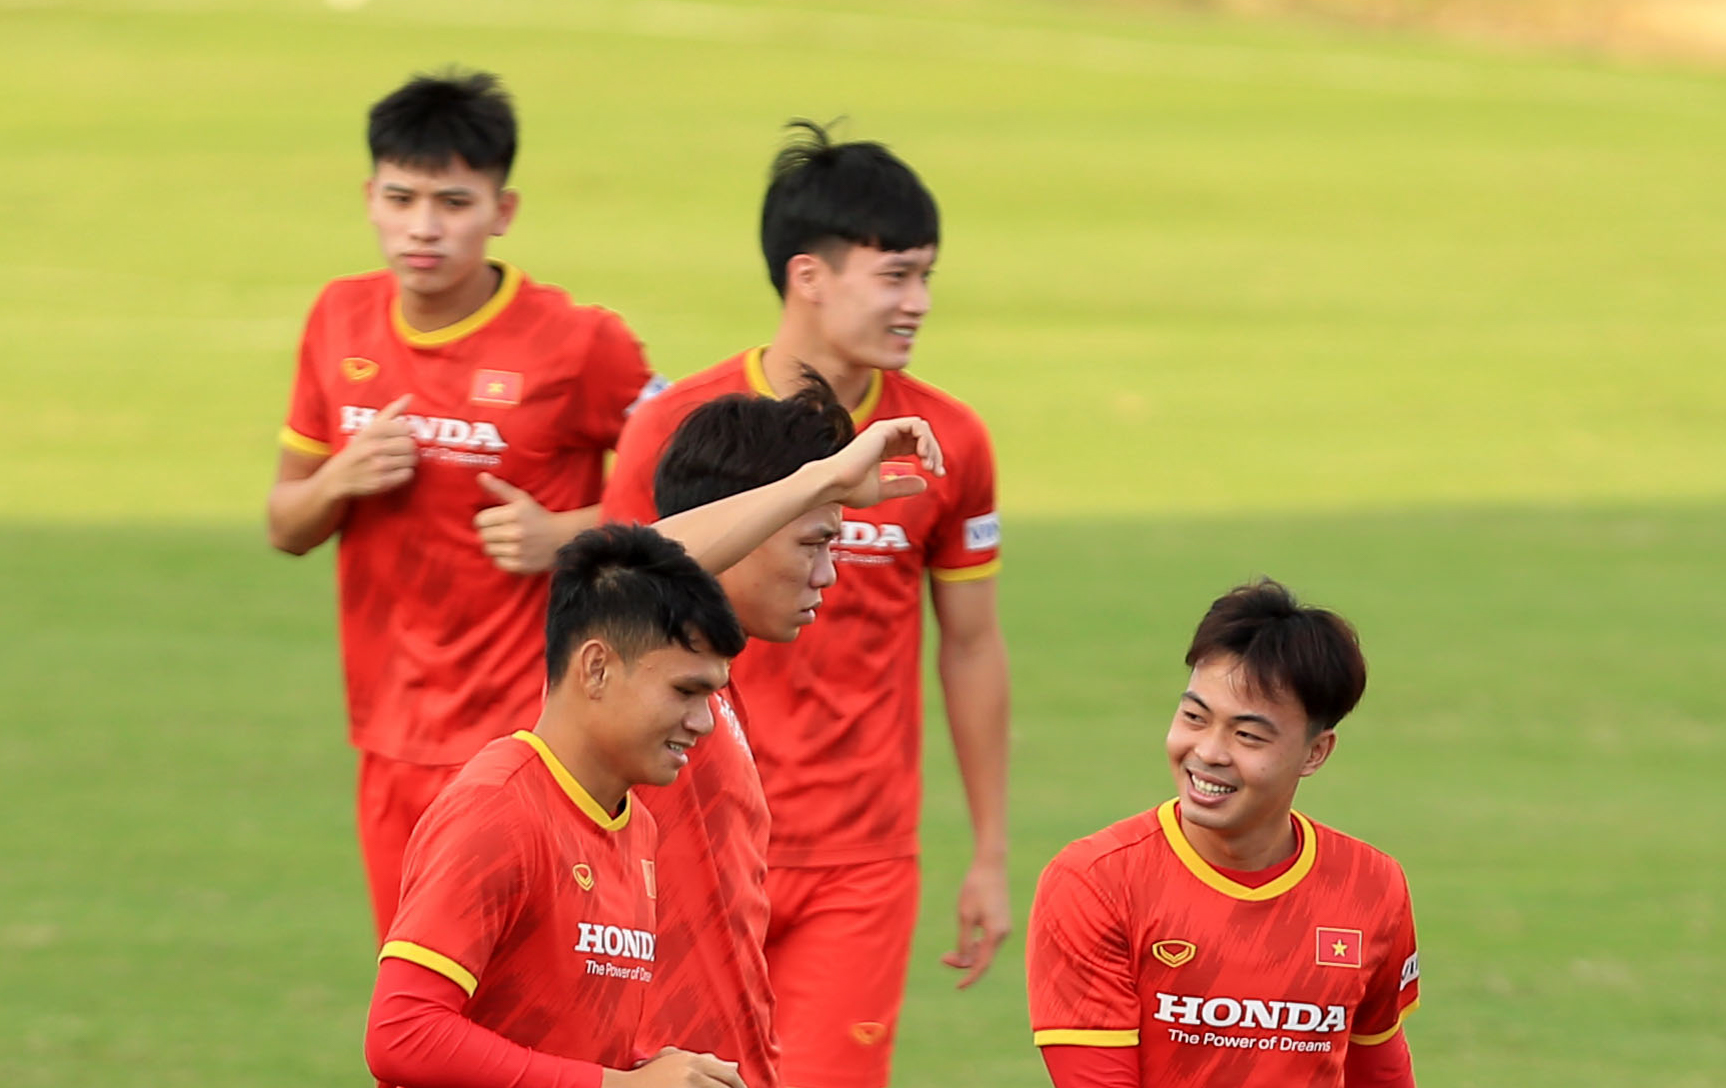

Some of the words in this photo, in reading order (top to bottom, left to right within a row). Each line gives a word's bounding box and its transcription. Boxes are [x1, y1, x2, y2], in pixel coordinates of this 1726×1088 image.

[340, 405, 508, 449] HNDA
[574, 922, 656, 962] HOND
[585, 959, 605, 975] The
[606, 962, 631, 979] Power
[1153, 992, 1346, 1033] HONDA
[1168, 1028, 1199, 1045] The
[1203, 1032, 1254, 1049] Power
[1258, 1036, 1277, 1050] of
[1280, 1037, 1332, 1053] Dreams
